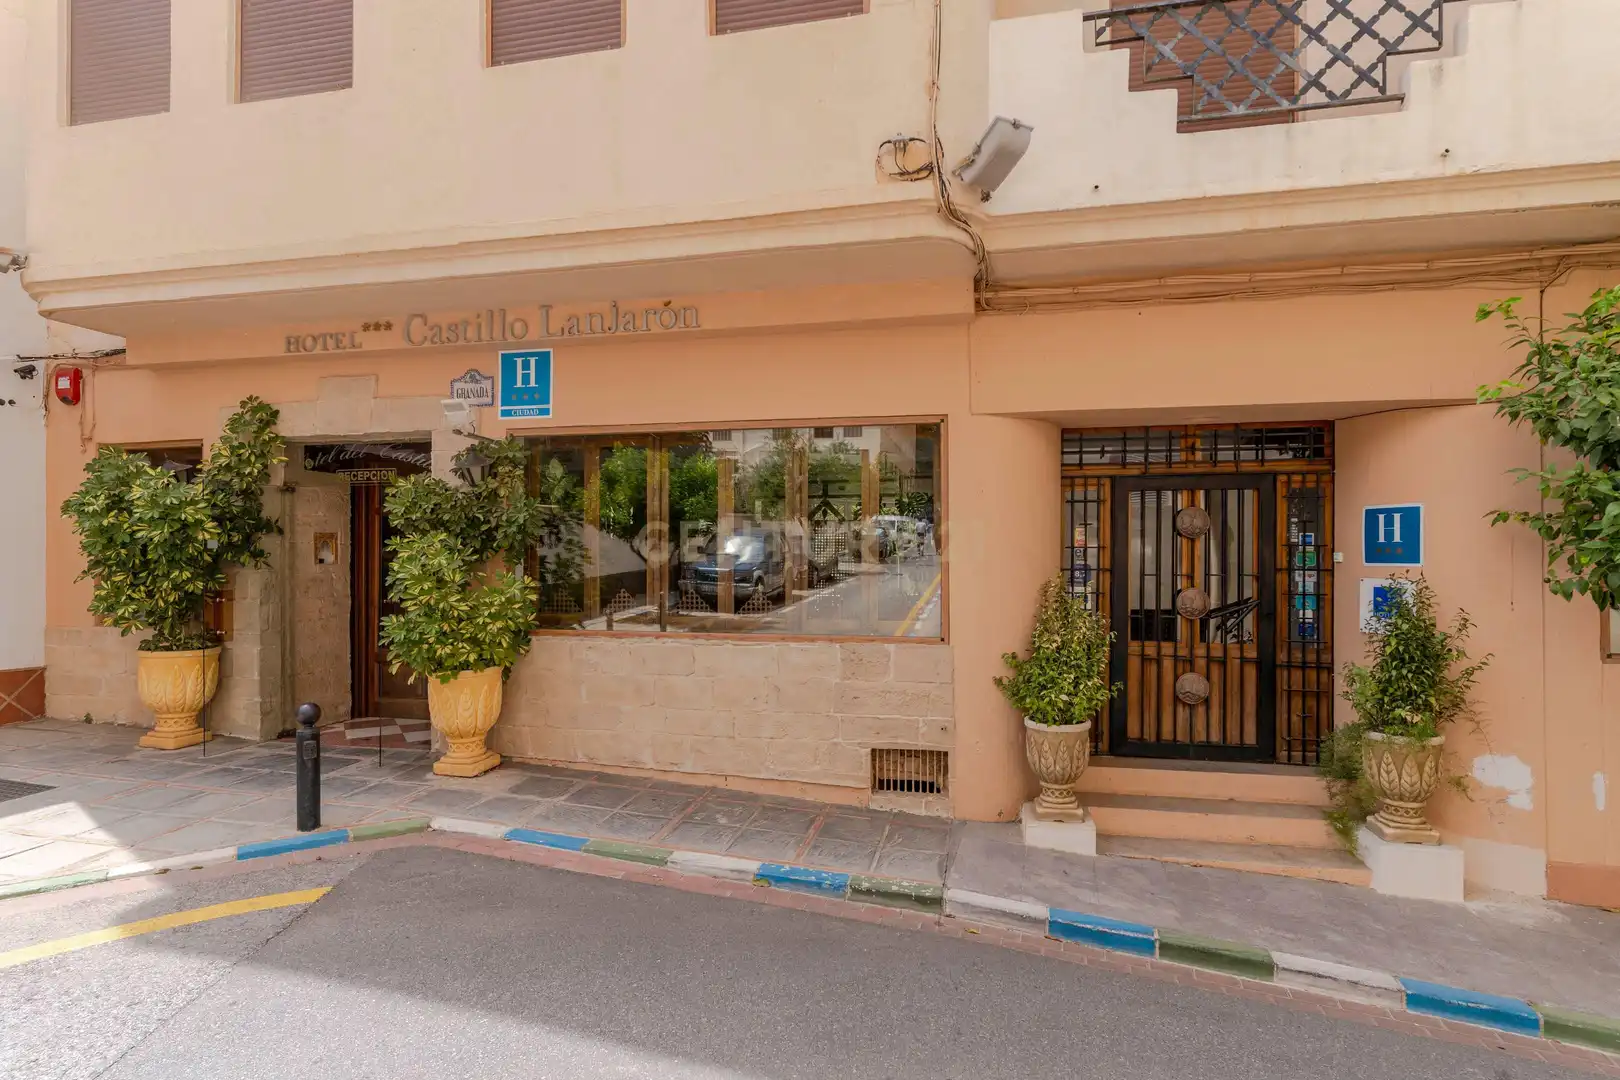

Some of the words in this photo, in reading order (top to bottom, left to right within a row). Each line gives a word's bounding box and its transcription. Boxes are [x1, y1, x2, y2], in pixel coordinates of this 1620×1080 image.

[284, 331, 362, 353] HOTEL
[404, 308, 528, 347] Castillo
[539, 300, 701, 339] Lanjarón
[513, 356, 539, 388] H
[456, 386, 489, 399] GRANADA
[511, 408, 539, 417] CIUDAD
[1376, 512, 1404, 543] H
